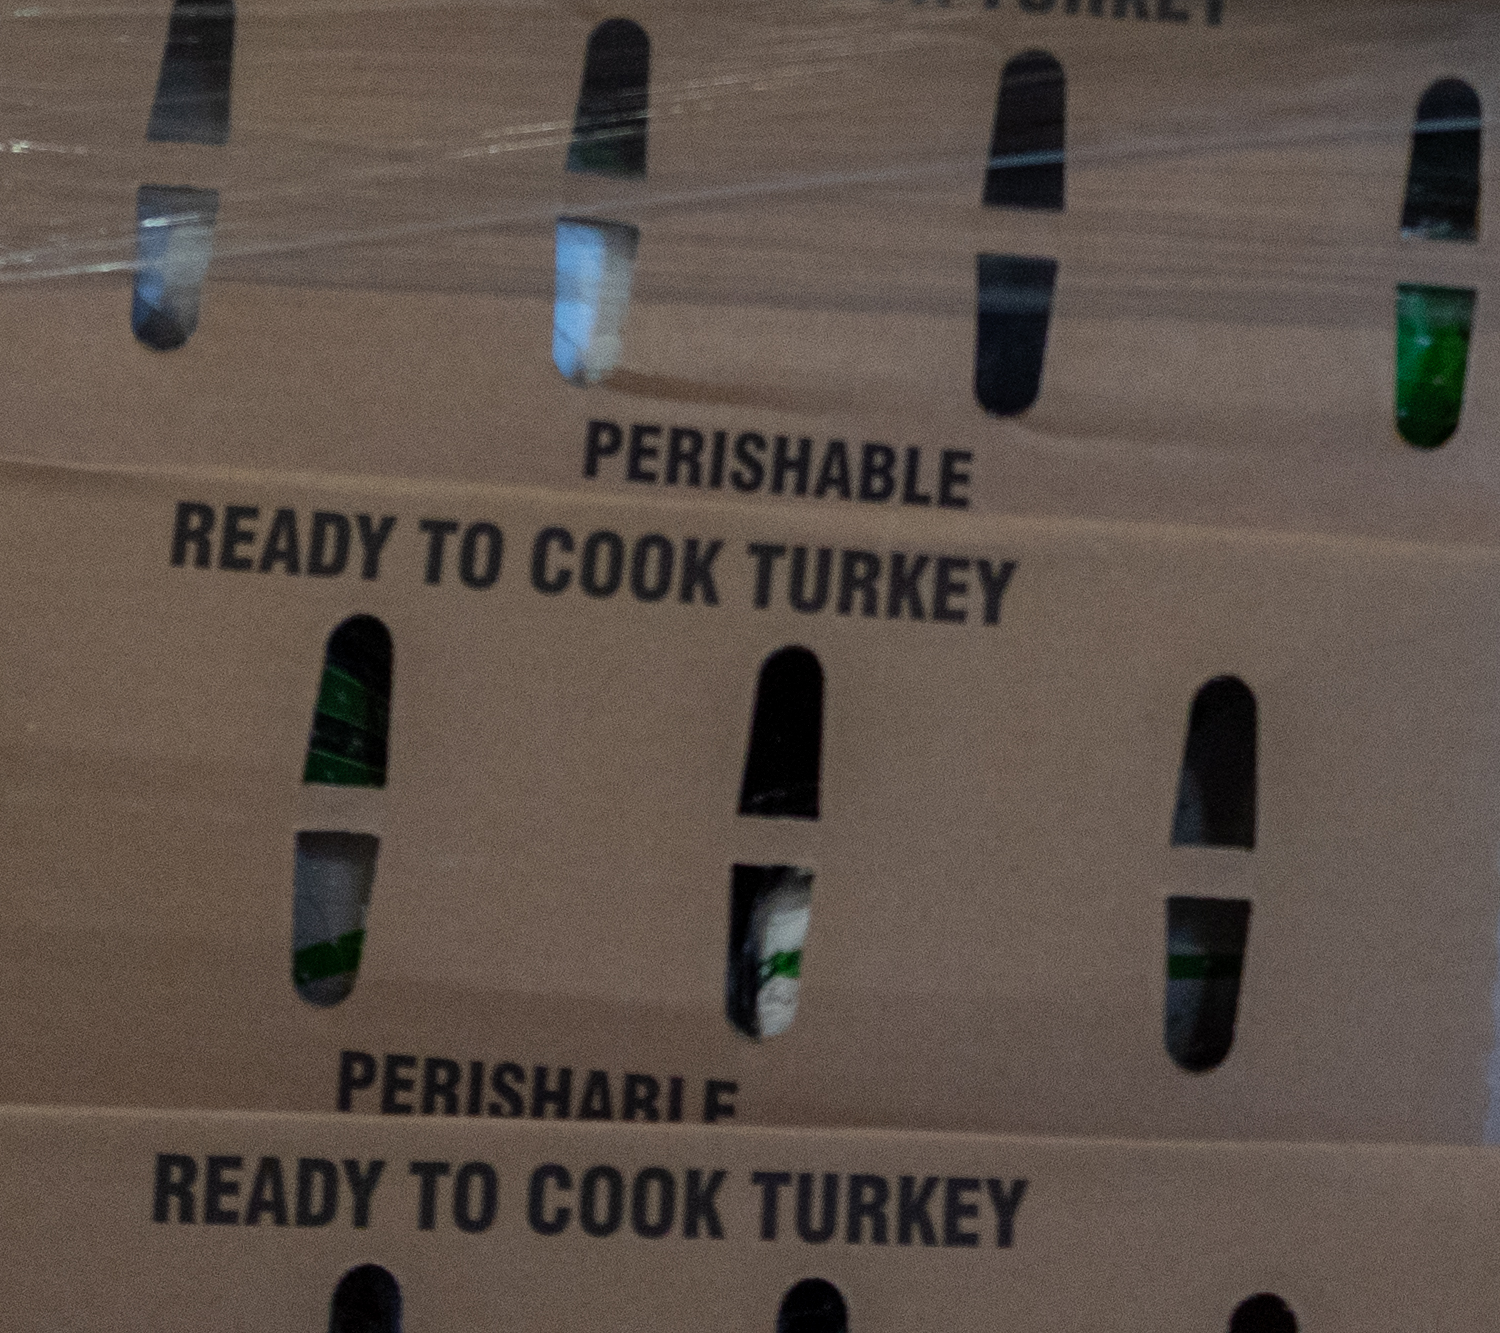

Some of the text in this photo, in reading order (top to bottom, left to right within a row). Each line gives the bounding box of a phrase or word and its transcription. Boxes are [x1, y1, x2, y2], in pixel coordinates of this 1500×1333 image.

[583, 420, 975, 512] PERISHABLE
[169, 501, 1021, 627] READY TO COOK TURKEY
[151, 1150, 1029, 1249] READY TO COOK TURKEY
